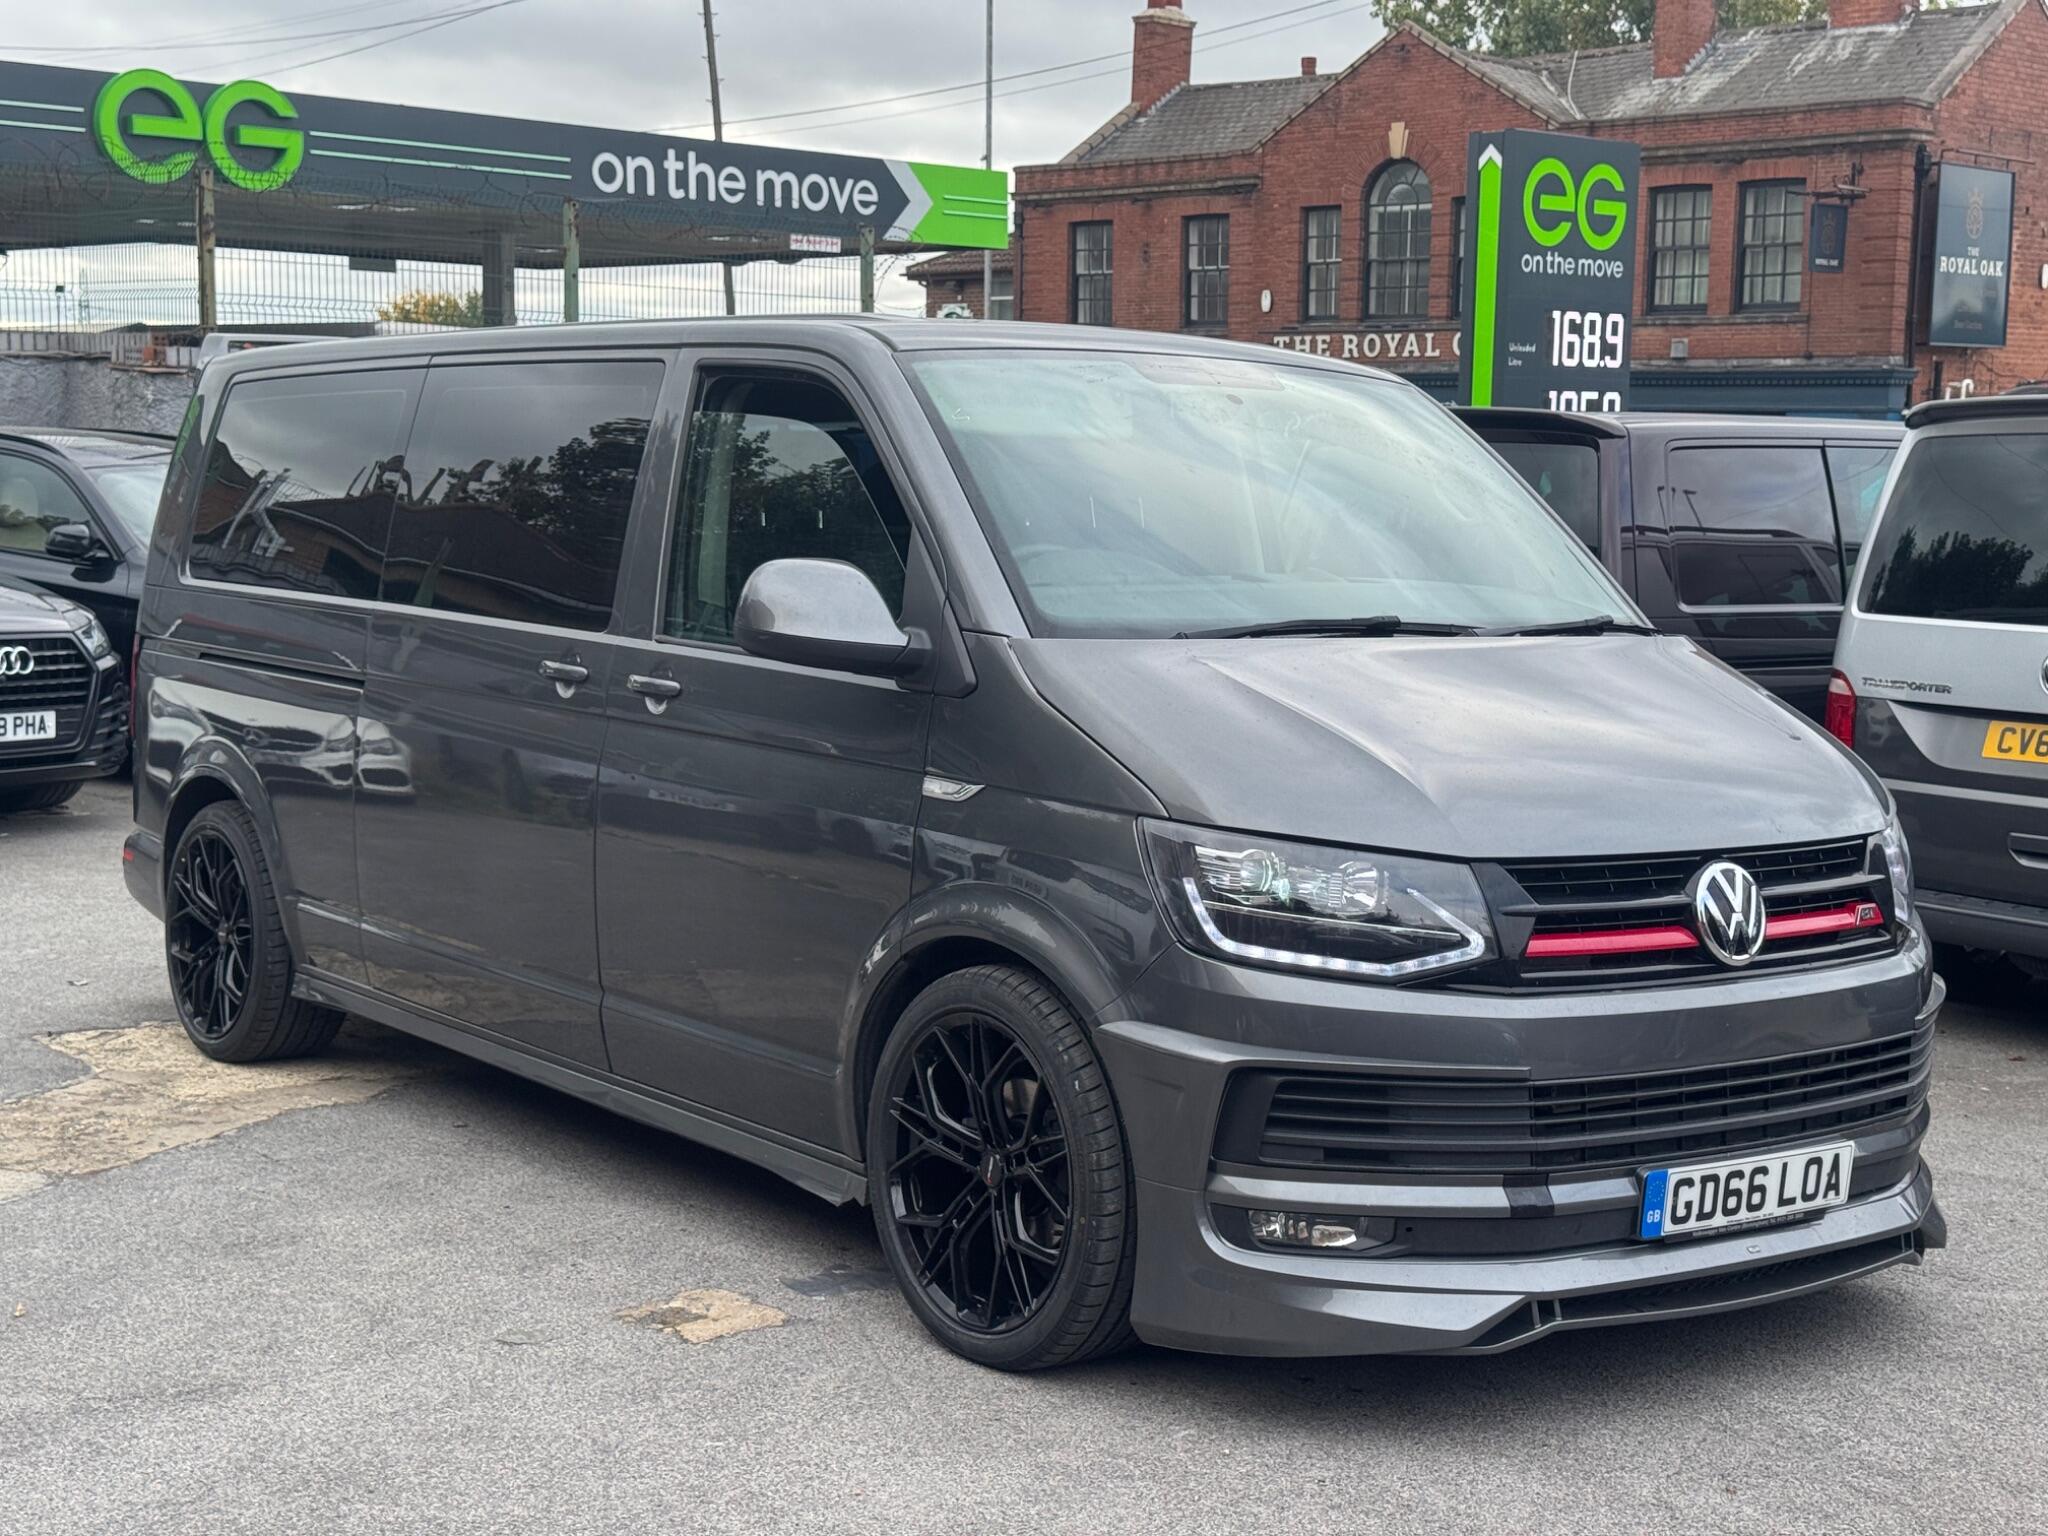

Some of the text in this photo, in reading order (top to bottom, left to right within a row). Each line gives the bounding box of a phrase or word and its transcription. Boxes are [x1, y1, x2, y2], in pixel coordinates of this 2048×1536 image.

[592, 148, 879, 216] on the move
[1521, 250, 1624, 278] on the move
[1968, 246, 1980, 257] THE
[1940, 255, 2004, 277] ROYAL OAK
[1273, 335, 1331, 357] THE
[1342, 332, 1440, 358] ROYAL
[1552, 310, 1624, 368] 168.9
[13, 715, 47, 736] PHA
[1670, 1165, 1769, 1226] GD66
[1647, 1209, 1660, 1223] GB
